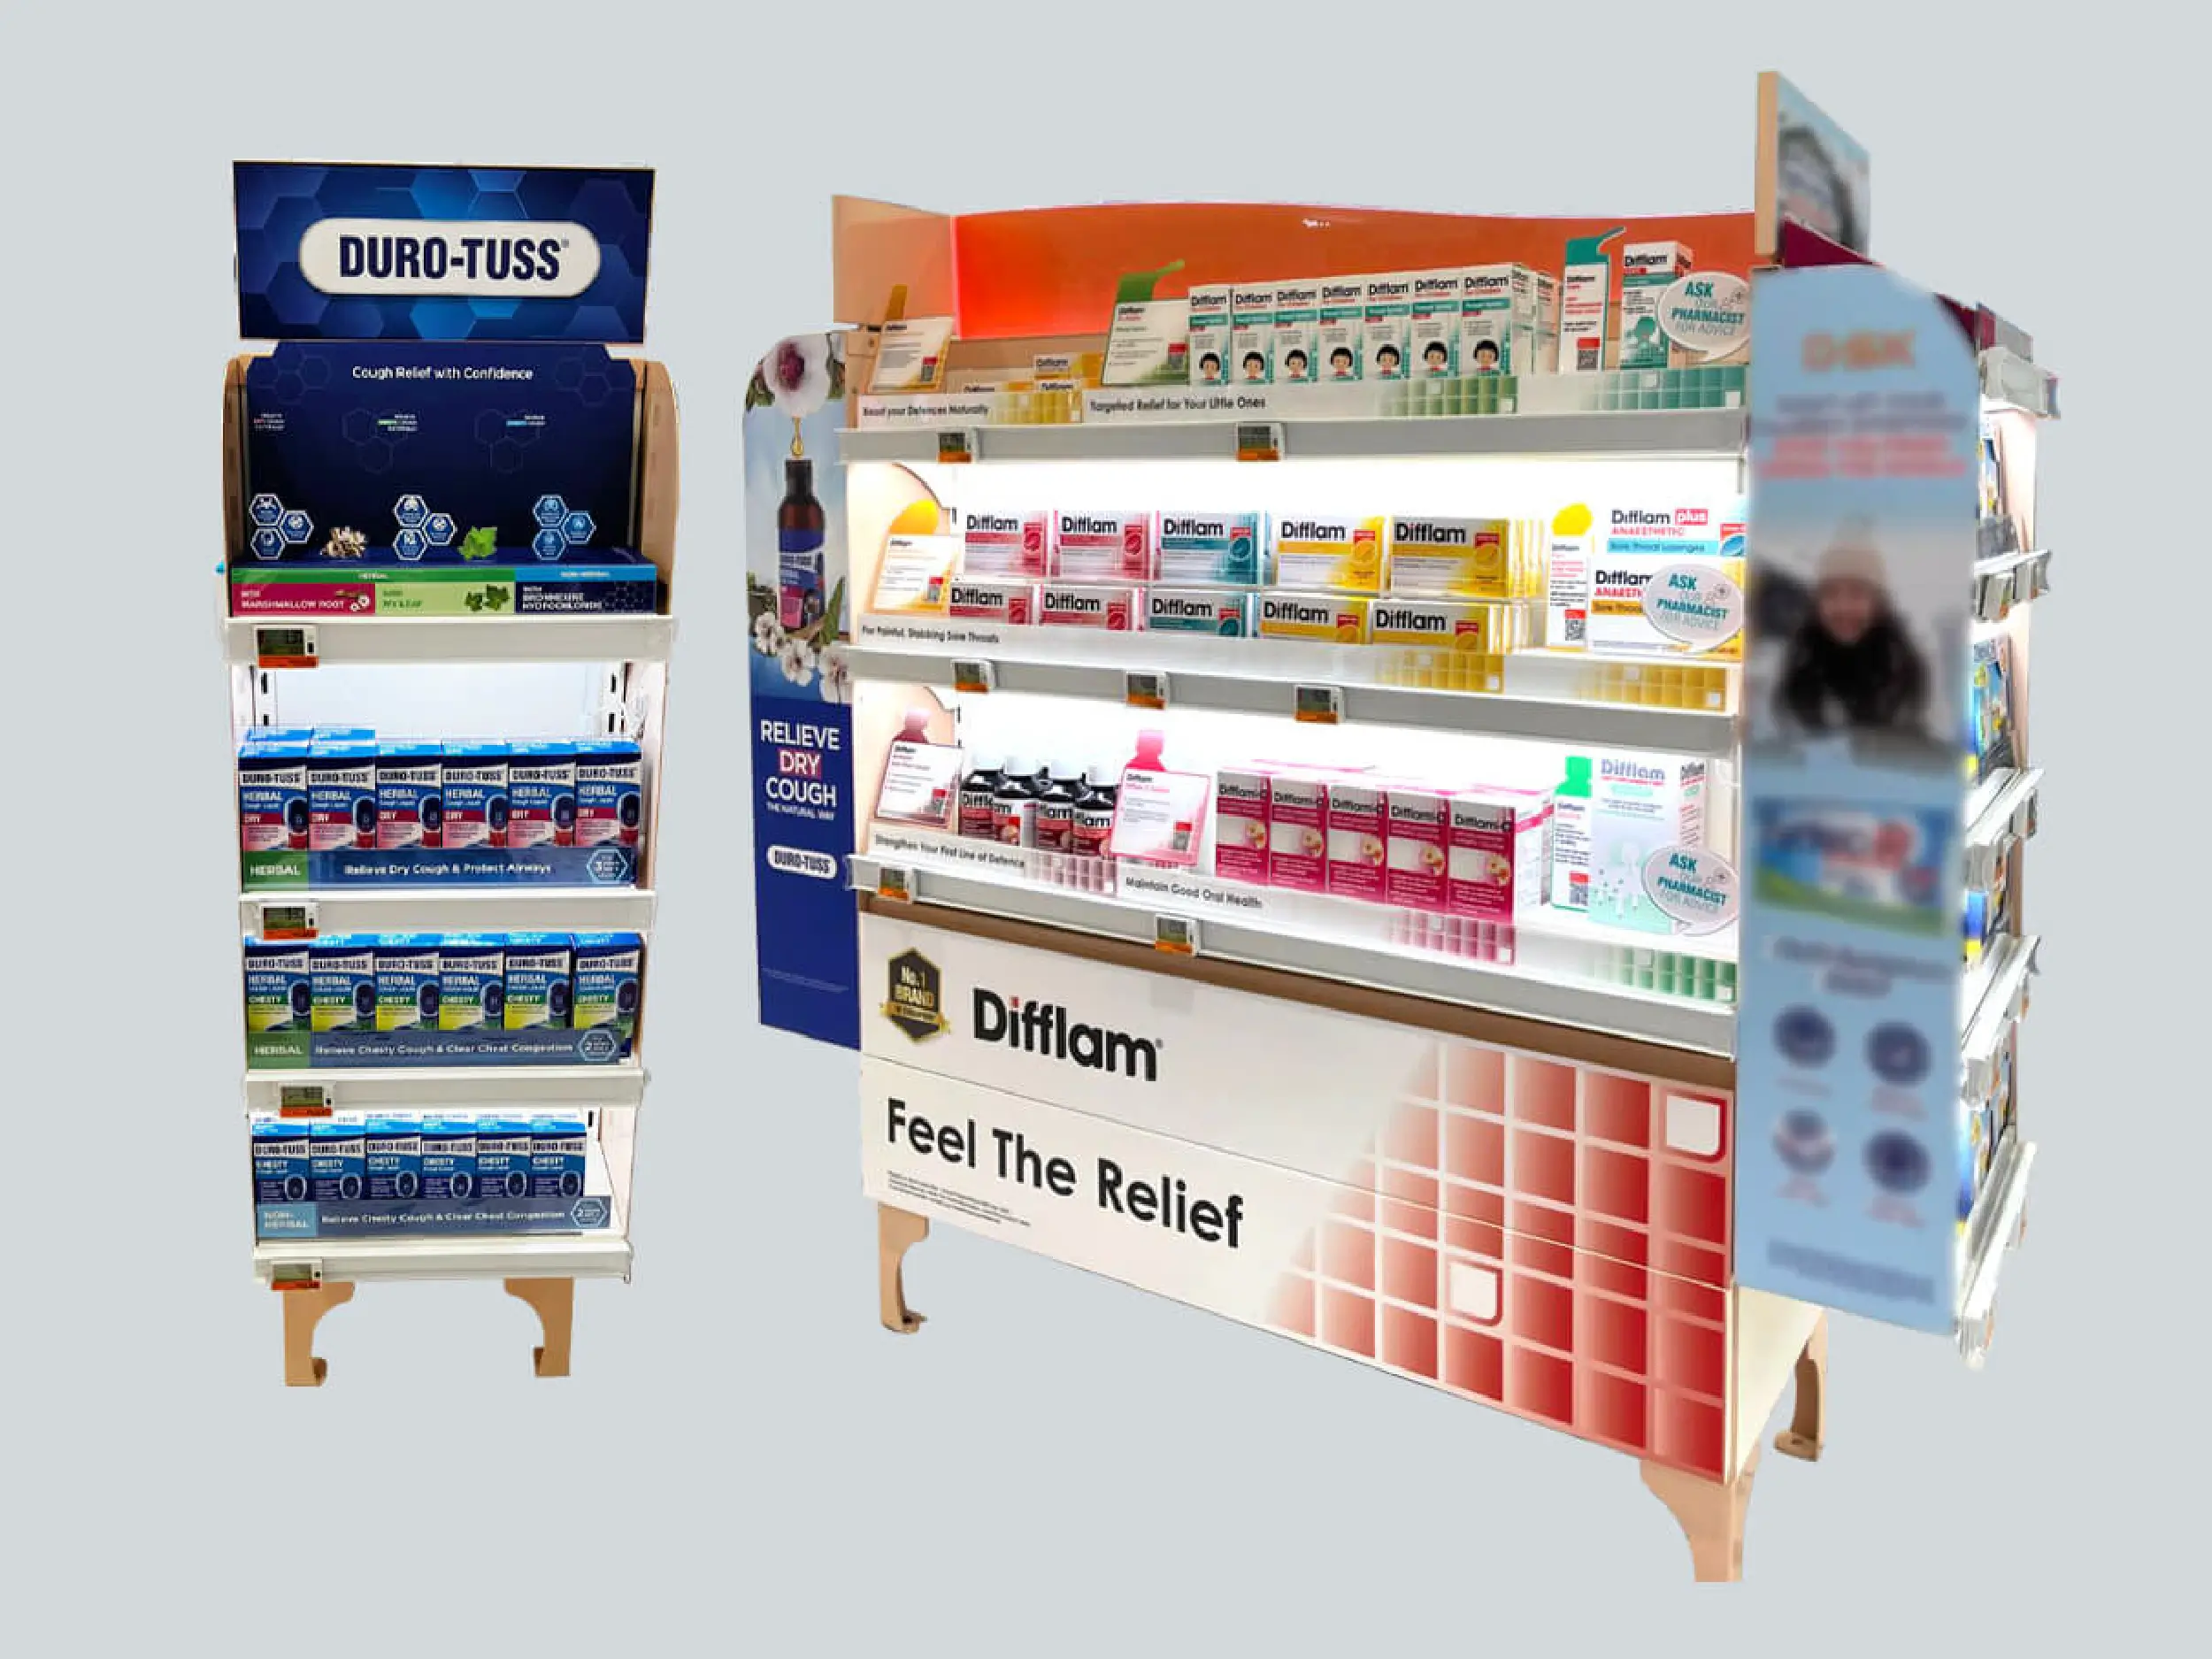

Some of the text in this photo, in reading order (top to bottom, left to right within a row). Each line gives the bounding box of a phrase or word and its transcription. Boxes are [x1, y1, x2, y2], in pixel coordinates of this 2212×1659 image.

[338, 234, 561, 282] DURO-TUSS
[1685, 281, 1714, 297] ASK
[1671, 308, 1745, 324] PHARMACIST
[352, 365, 534, 380] Cough Relief with Confidence
[1090, 401, 1134, 414] Targeted
[1137, 399, 1164, 410] Relief
[1166, 399, 1181, 410] for
[1209, 397, 1234, 409] Little
[1238, 396, 1266, 409] Ones
[967, 514, 1018, 530] Difflam
[1062, 516, 1117, 533] Difflam
[1164, 518, 1224, 535] Difflam
[1611, 509, 1707, 525] Difflam plus
[1281, 521, 1346, 541] Difflam
[1394, 522, 1466, 542] Difflam
[1668, 572, 1697, 590] ASK
[319, 600, 345, 609] ROOT
[951, 587, 1002, 605] Difflam
[1045, 592, 1100, 611] Difflam
[1152, 598, 1212, 617] Difflam
[1263, 601, 1329, 623] Difflam
[1656, 598, 1730, 619] PHARMACIST
[1376, 609, 1447, 631] Difflam
[760, 718, 841, 751] RELIEVE
[779, 750, 821, 775] DRY
[1601, 758, 1665, 780] Difflam
[765, 776, 838, 808] COUGH
[250, 864, 302, 875] HERBAL
[343, 864, 387, 875] Relieve
[388, 864, 410, 877] Dry
[413, 864, 449, 876] Cough
[464, 864, 504, 874] Protect
[507, 864, 551, 877] Airways
[774, 849, 831, 874] DURO-TUSS
[1669, 853, 1698, 873] ASK
[1125, 877, 1169, 893] Maintain
[1171, 884, 1200, 899] Good
[1226, 892, 1263, 909] Health
[1658, 876, 1727, 906] PHARMACIST
[895, 984, 934, 1008] BRAND
[972, 987, 1157, 1082] Difflam
[254, 1045, 303, 1055] HERBAL
[315, 1044, 354, 1054] Relieve
[357, 1045, 396, 1056] Chesty
[397, 1044, 434, 1056] Cough
[445, 1043, 475, 1053] Clear
[478, 1043, 509, 1053] Chest
[511, 1044, 573, 1055] Congestion
[887, 1096, 975, 1169] Feel
[991, 1126, 1077, 1197] The
[1097, 1156, 1244, 1248] Relief
[444, 1212, 472, 1222] Clear
[474, 1212, 503, 1222] Chest
